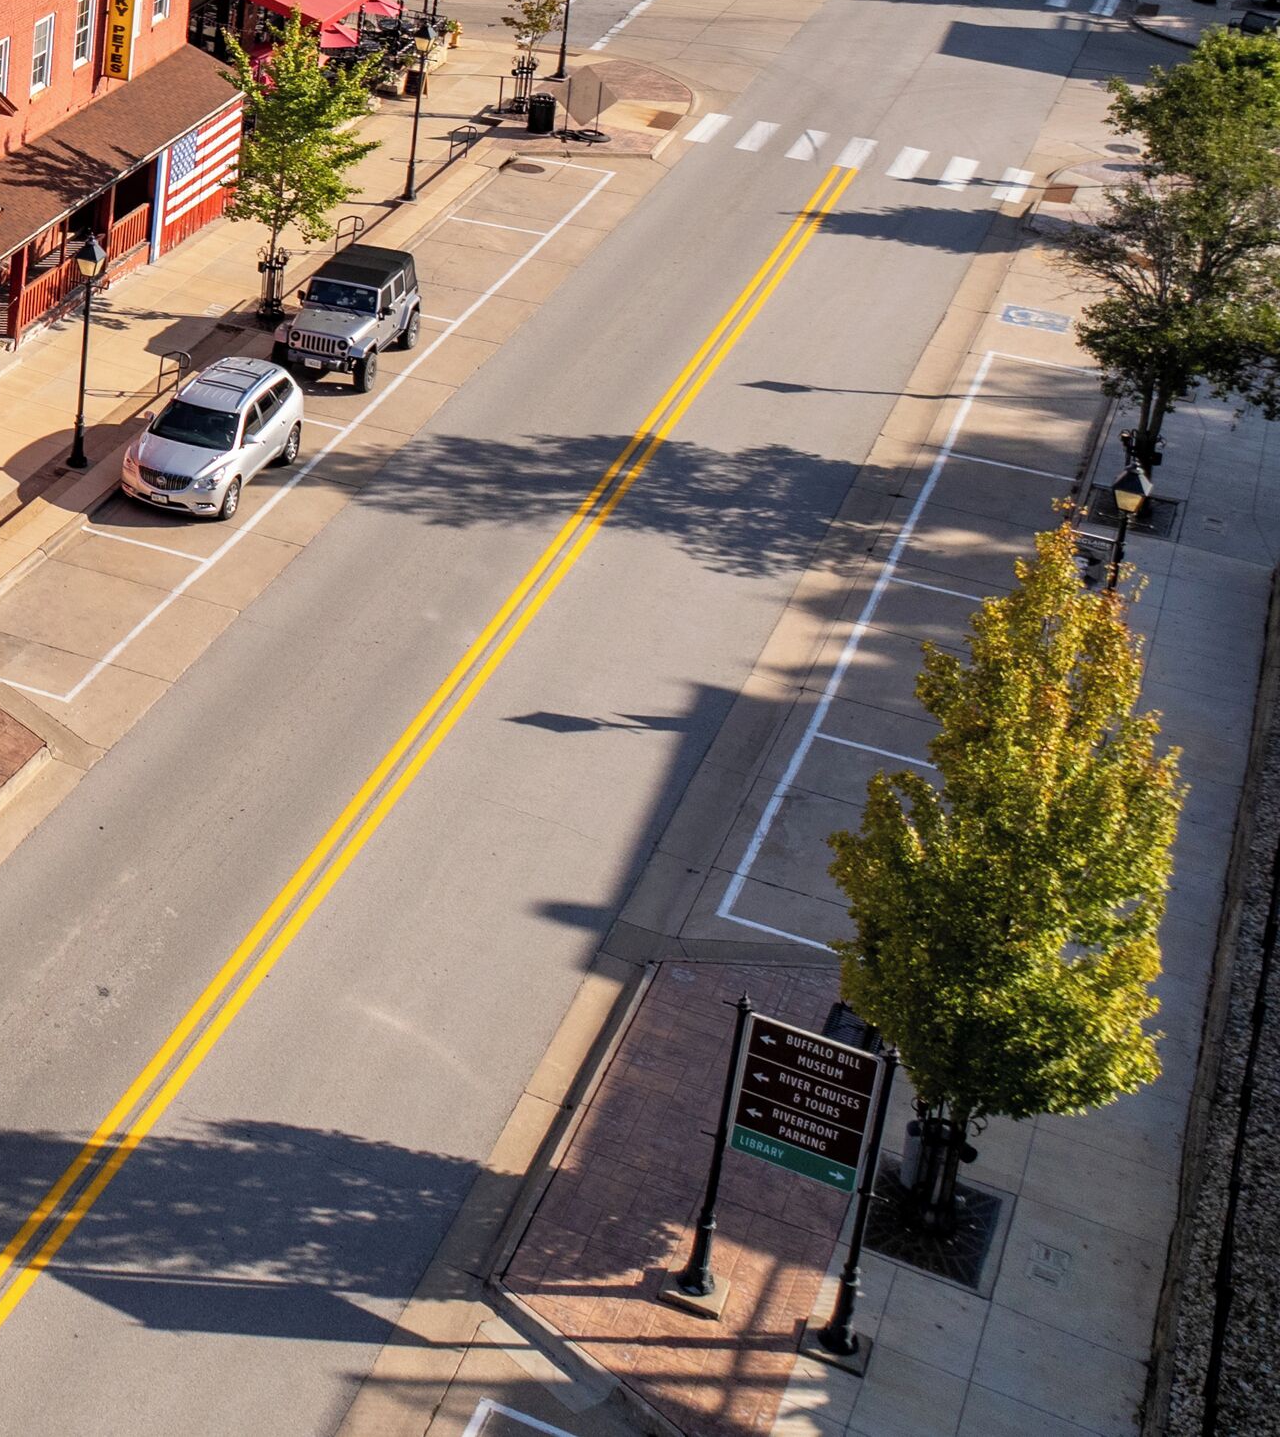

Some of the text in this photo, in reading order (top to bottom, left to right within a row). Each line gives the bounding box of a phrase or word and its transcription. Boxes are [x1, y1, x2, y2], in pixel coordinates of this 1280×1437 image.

[786, 1034, 861, 1070] BUFFALO BILL
[797, 1055, 844, 1080] MUSEUM
[779, 1072, 860, 1110] RIVER CRUISES
[793, 1093, 841, 1118] & TOURS
[772, 1108, 840, 1141] RIVERFRONT
[739, 1135, 785, 1159] LIBRARY
[778, 1125, 827, 1151] PARKING
